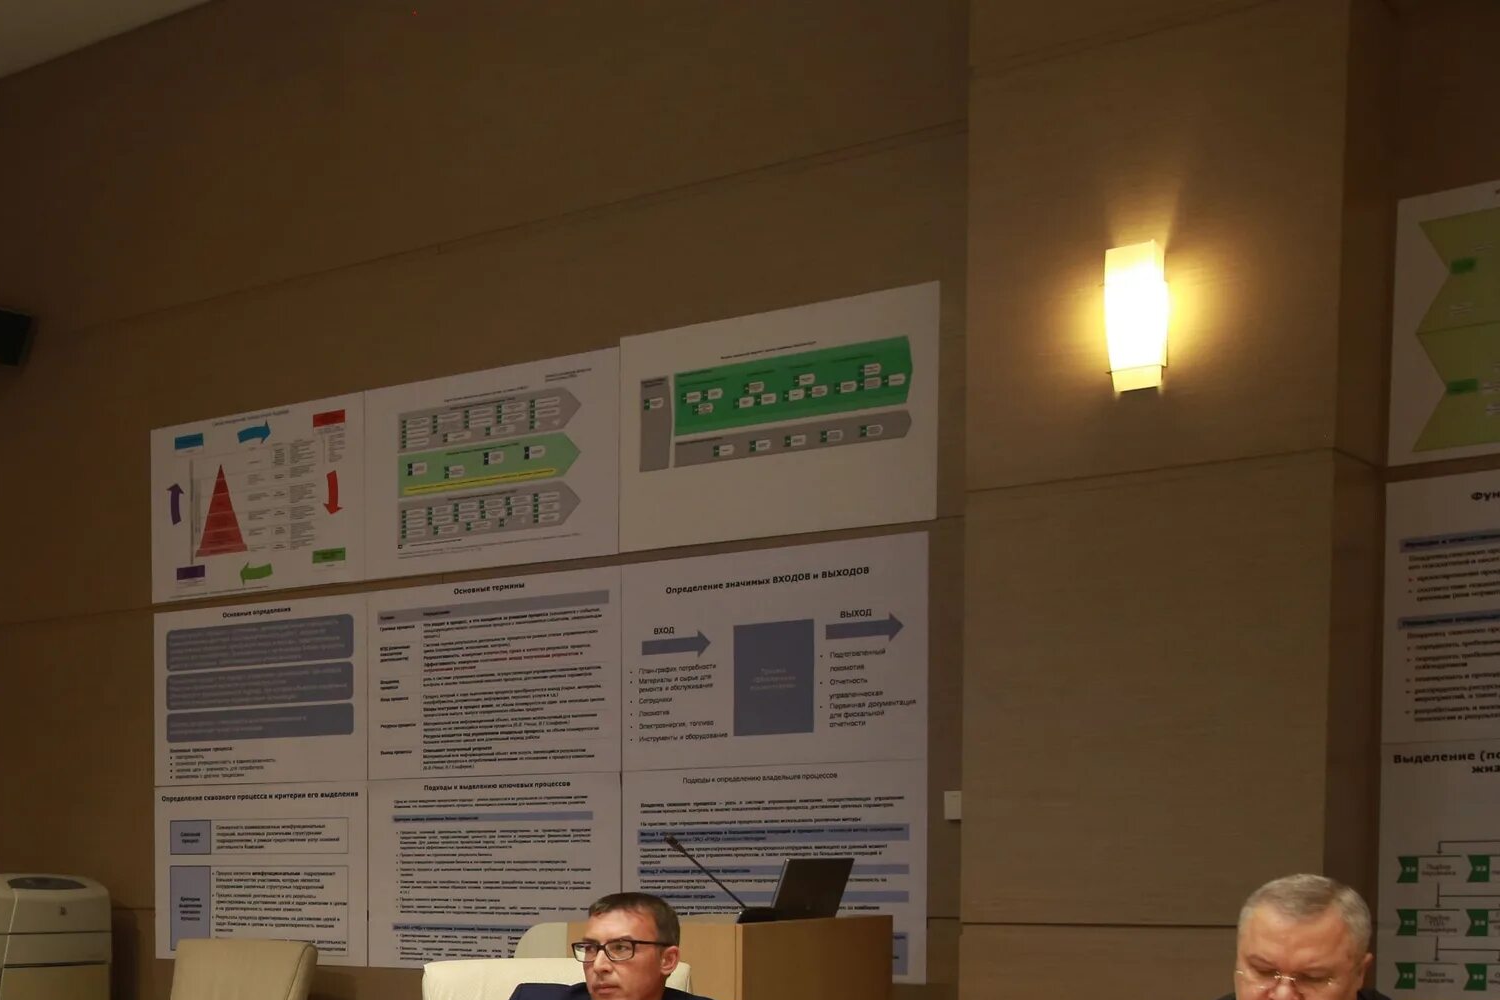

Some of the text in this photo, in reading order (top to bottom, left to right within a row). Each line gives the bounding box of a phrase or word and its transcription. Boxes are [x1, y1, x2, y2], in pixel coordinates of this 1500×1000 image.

[1470, 491, 1500, 501] Фун
[665, 582, 723, 594] Определение
[725, 577, 770, 589] значимых
[772, 572, 811, 585] ВХОДОВ
[821, 566, 870, 579] ВЫХОДОВ
[453, 582, 525, 595] Основные термины
[840, 608, 872, 619] ВЫХОД
[653, 626, 675, 635] ВХОД
[1393, 750, 1500, 764] Выделение (по
[1471, 765, 1500, 774] жиз
[682, 776, 711, 785] Подходы
[716, 774, 762, 784] определению
[802, 772, 838, 781] процессов
[534, 780, 571, 789] процессов
[237, 793, 268, 802] процесса
